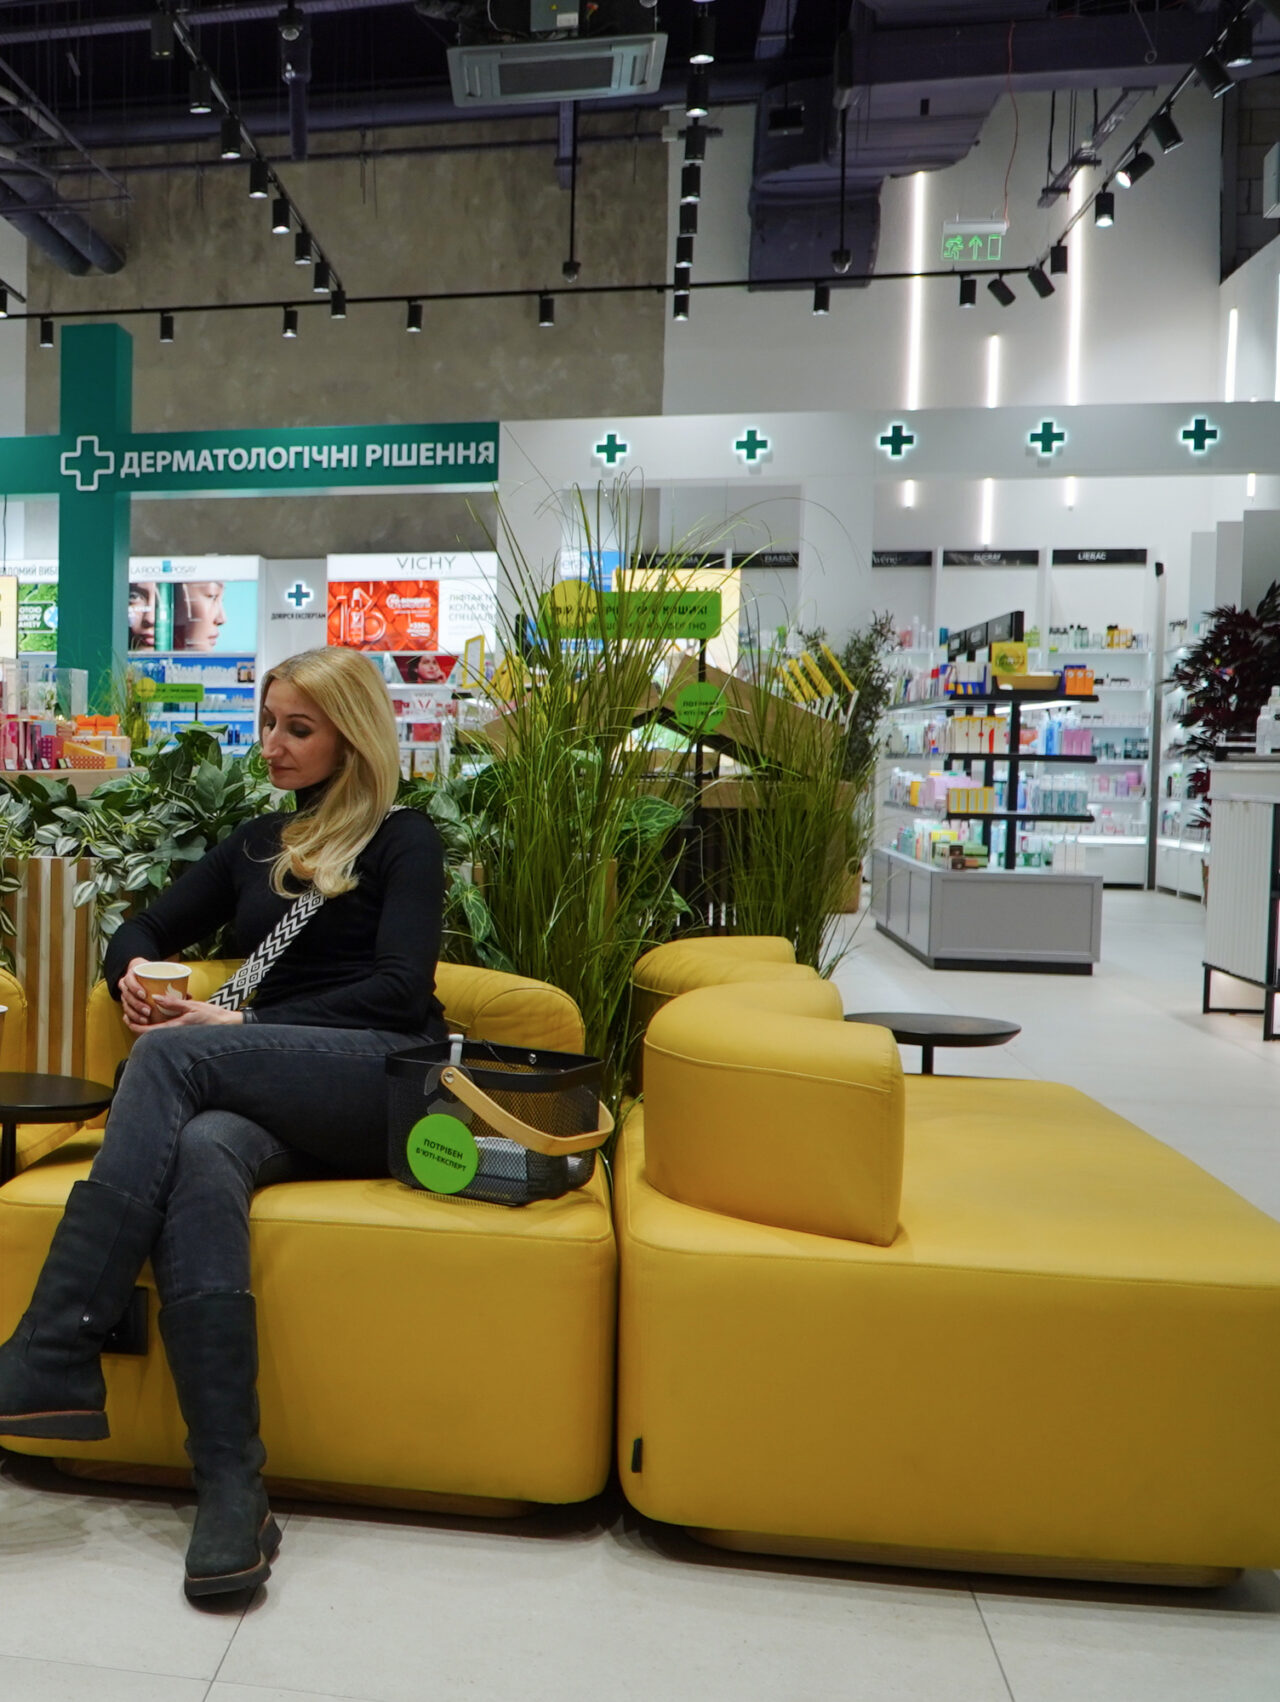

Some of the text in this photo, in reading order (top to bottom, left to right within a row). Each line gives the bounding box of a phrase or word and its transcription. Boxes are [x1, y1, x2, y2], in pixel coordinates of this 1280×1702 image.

[120, 441, 495, 479] ДЕРМАТОЛОГІЧНІ РІШЕННЯ
[397, 555, 457, 570] VICHY
[423, 1138, 464, 1160] ПОТРІБЕН
